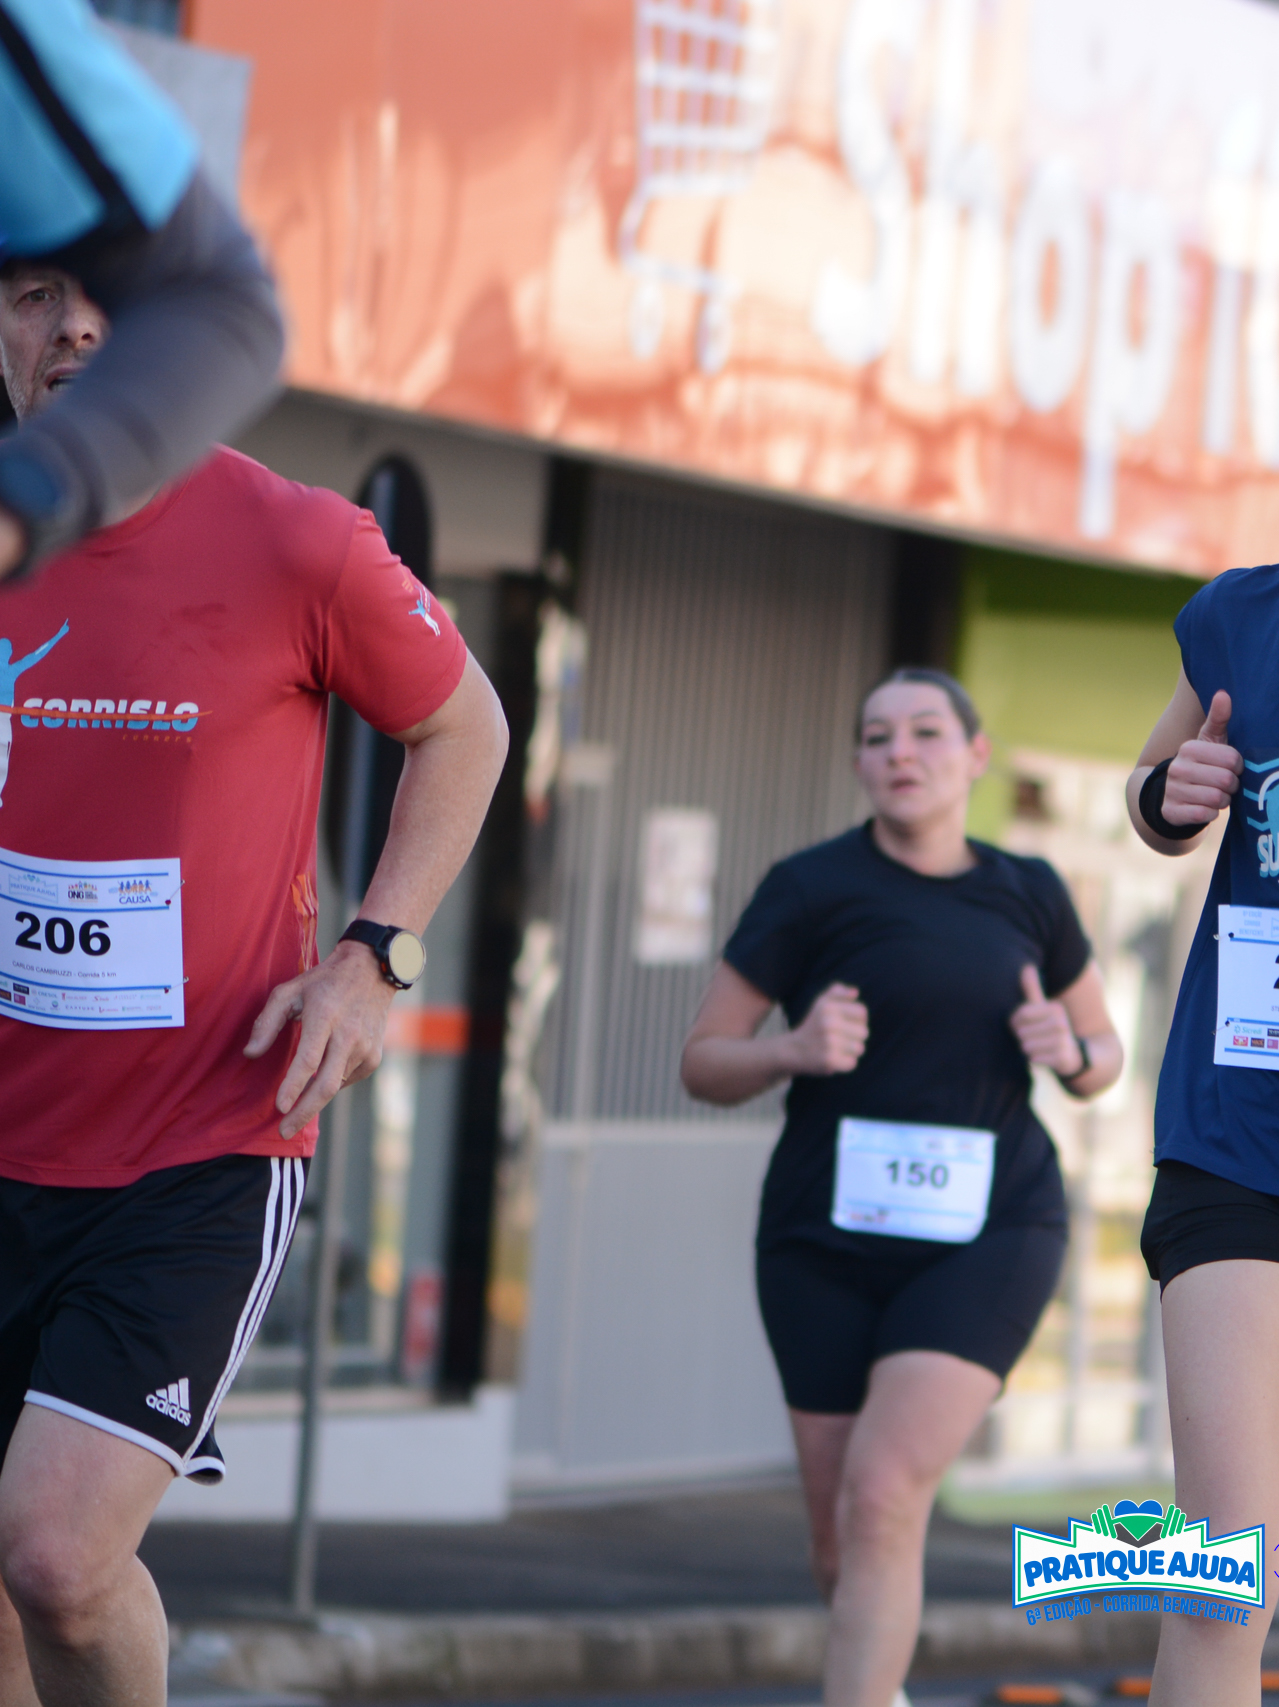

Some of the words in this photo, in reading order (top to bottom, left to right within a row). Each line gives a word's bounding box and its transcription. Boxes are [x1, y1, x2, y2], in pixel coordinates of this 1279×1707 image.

[118, 895, 152, 905] CAUSA
[15, 911, 111, 956] 206
[12, 960, 35, 972] CARLOS
[887, 1160, 950, 1189] 150
[145, 1393, 192, 1427] adidas
